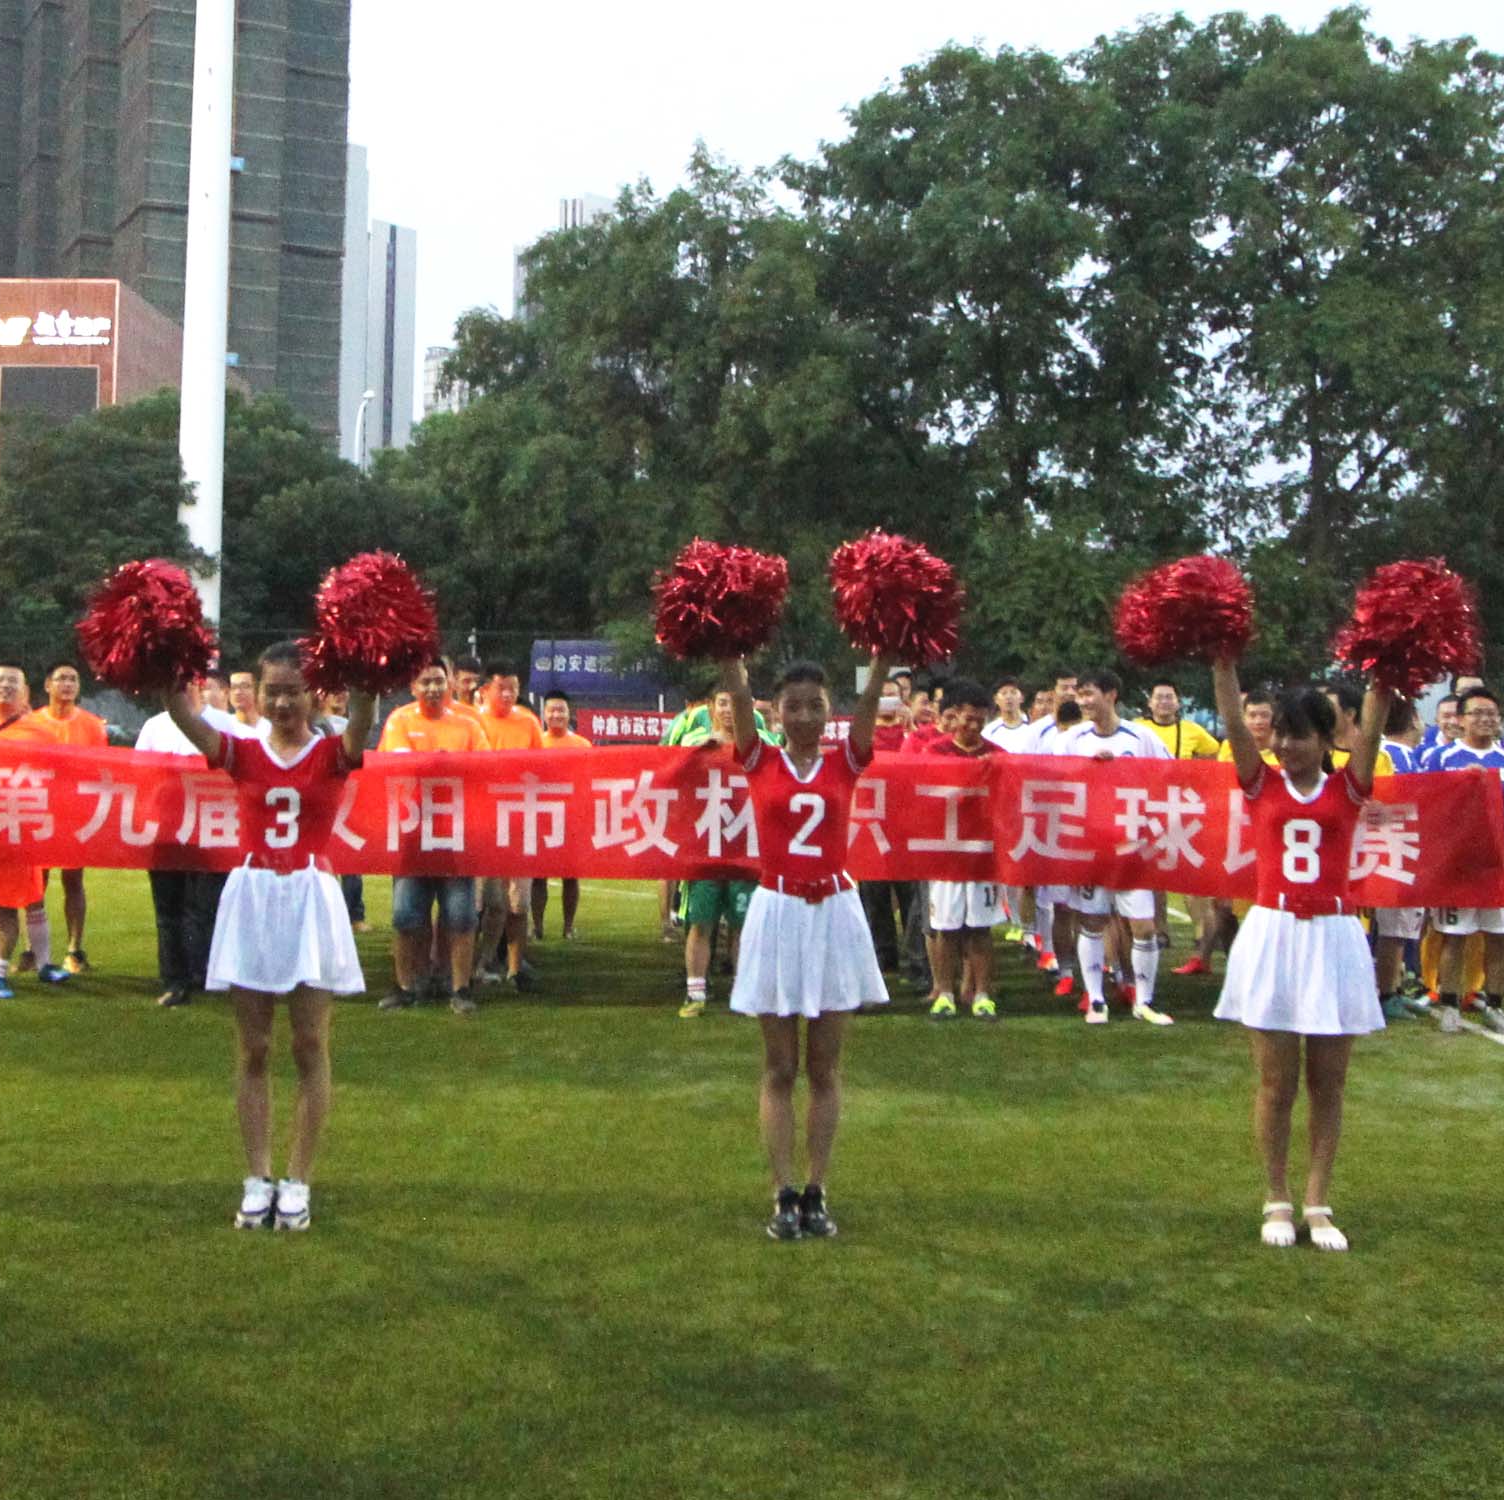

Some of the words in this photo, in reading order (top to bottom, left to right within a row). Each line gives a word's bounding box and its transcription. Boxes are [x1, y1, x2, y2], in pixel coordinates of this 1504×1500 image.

[264, 786, 301, 849] 3
[787, 793, 826, 858] 2
[1281, 818, 1322, 884] 8
